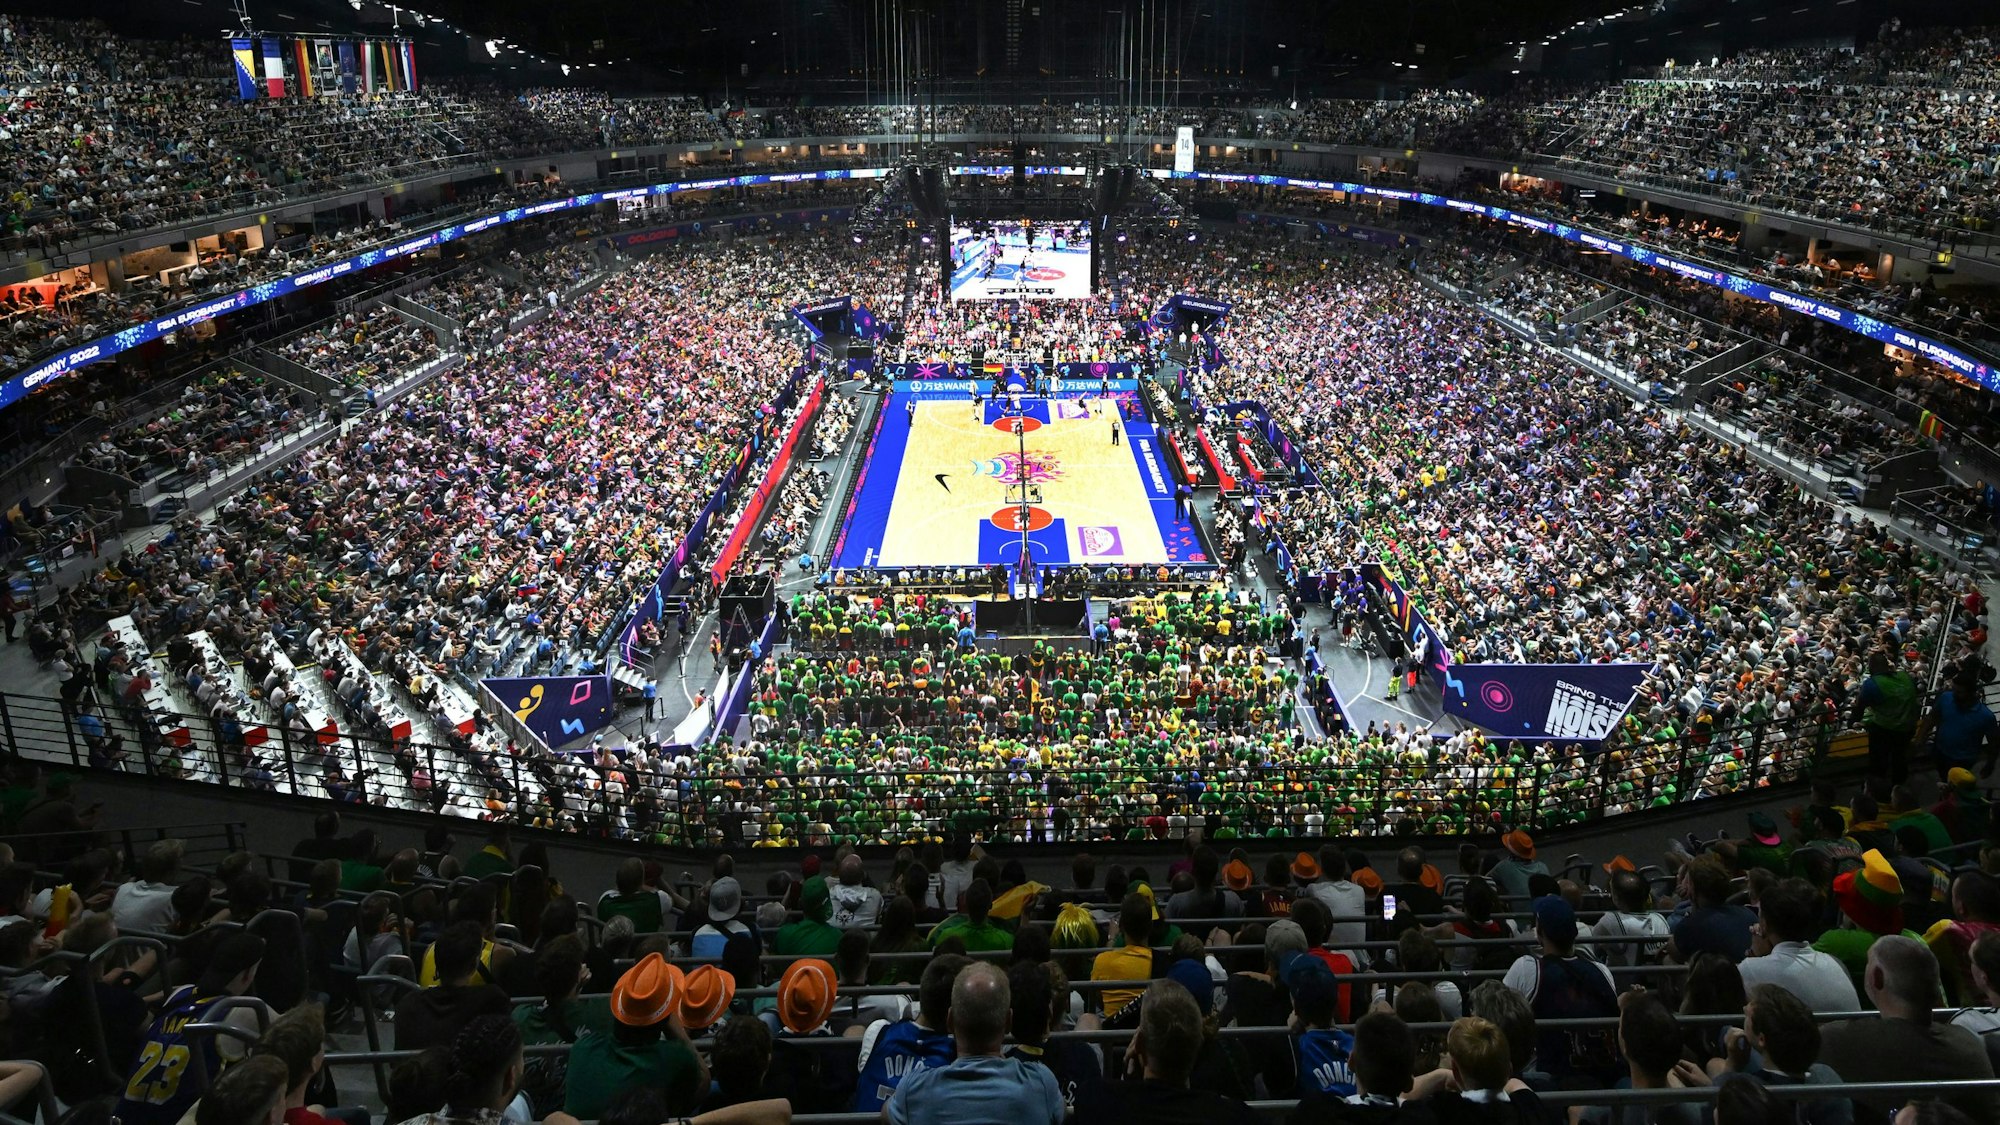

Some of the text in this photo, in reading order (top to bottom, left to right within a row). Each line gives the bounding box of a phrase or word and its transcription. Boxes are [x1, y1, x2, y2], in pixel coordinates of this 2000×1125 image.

[1181, 138, 1189, 150] 14
[769, 172, 816, 182] GERMANY 2022
[1288, 178, 1317, 187] GERMANY
[602, 188, 647, 199] GERMANY 2022
[1364, 187, 1412, 199] FIBA EUROBASKET
[1446, 200, 1474, 211] GERMANY
[464, 219, 486, 233] GERMANY
[386, 236, 432, 258] FIBA EUROBASKET
[1580, 234, 1623, 253] GERMANY 2022
[294, 262, 351, 287] GERMANY 2022
[1656, 257, 1713, 281] FIBA EUROBASKET
[157, 298, 235, 332] FIBA EUROBASKET
[800, 301, 843, 314] #EROBASKET
[1770, 291, 1842, 321] GERMANY 2022
[1894, 332, 1975, 373] FIBA EUROBASKET
[23, 345, 100, 389] GERMANY 2022
[1555, 680, 1628, 711] BRING THE
[1268, 900, 1292, 914] JAME
[124, 1040, 191, 1106] 23
